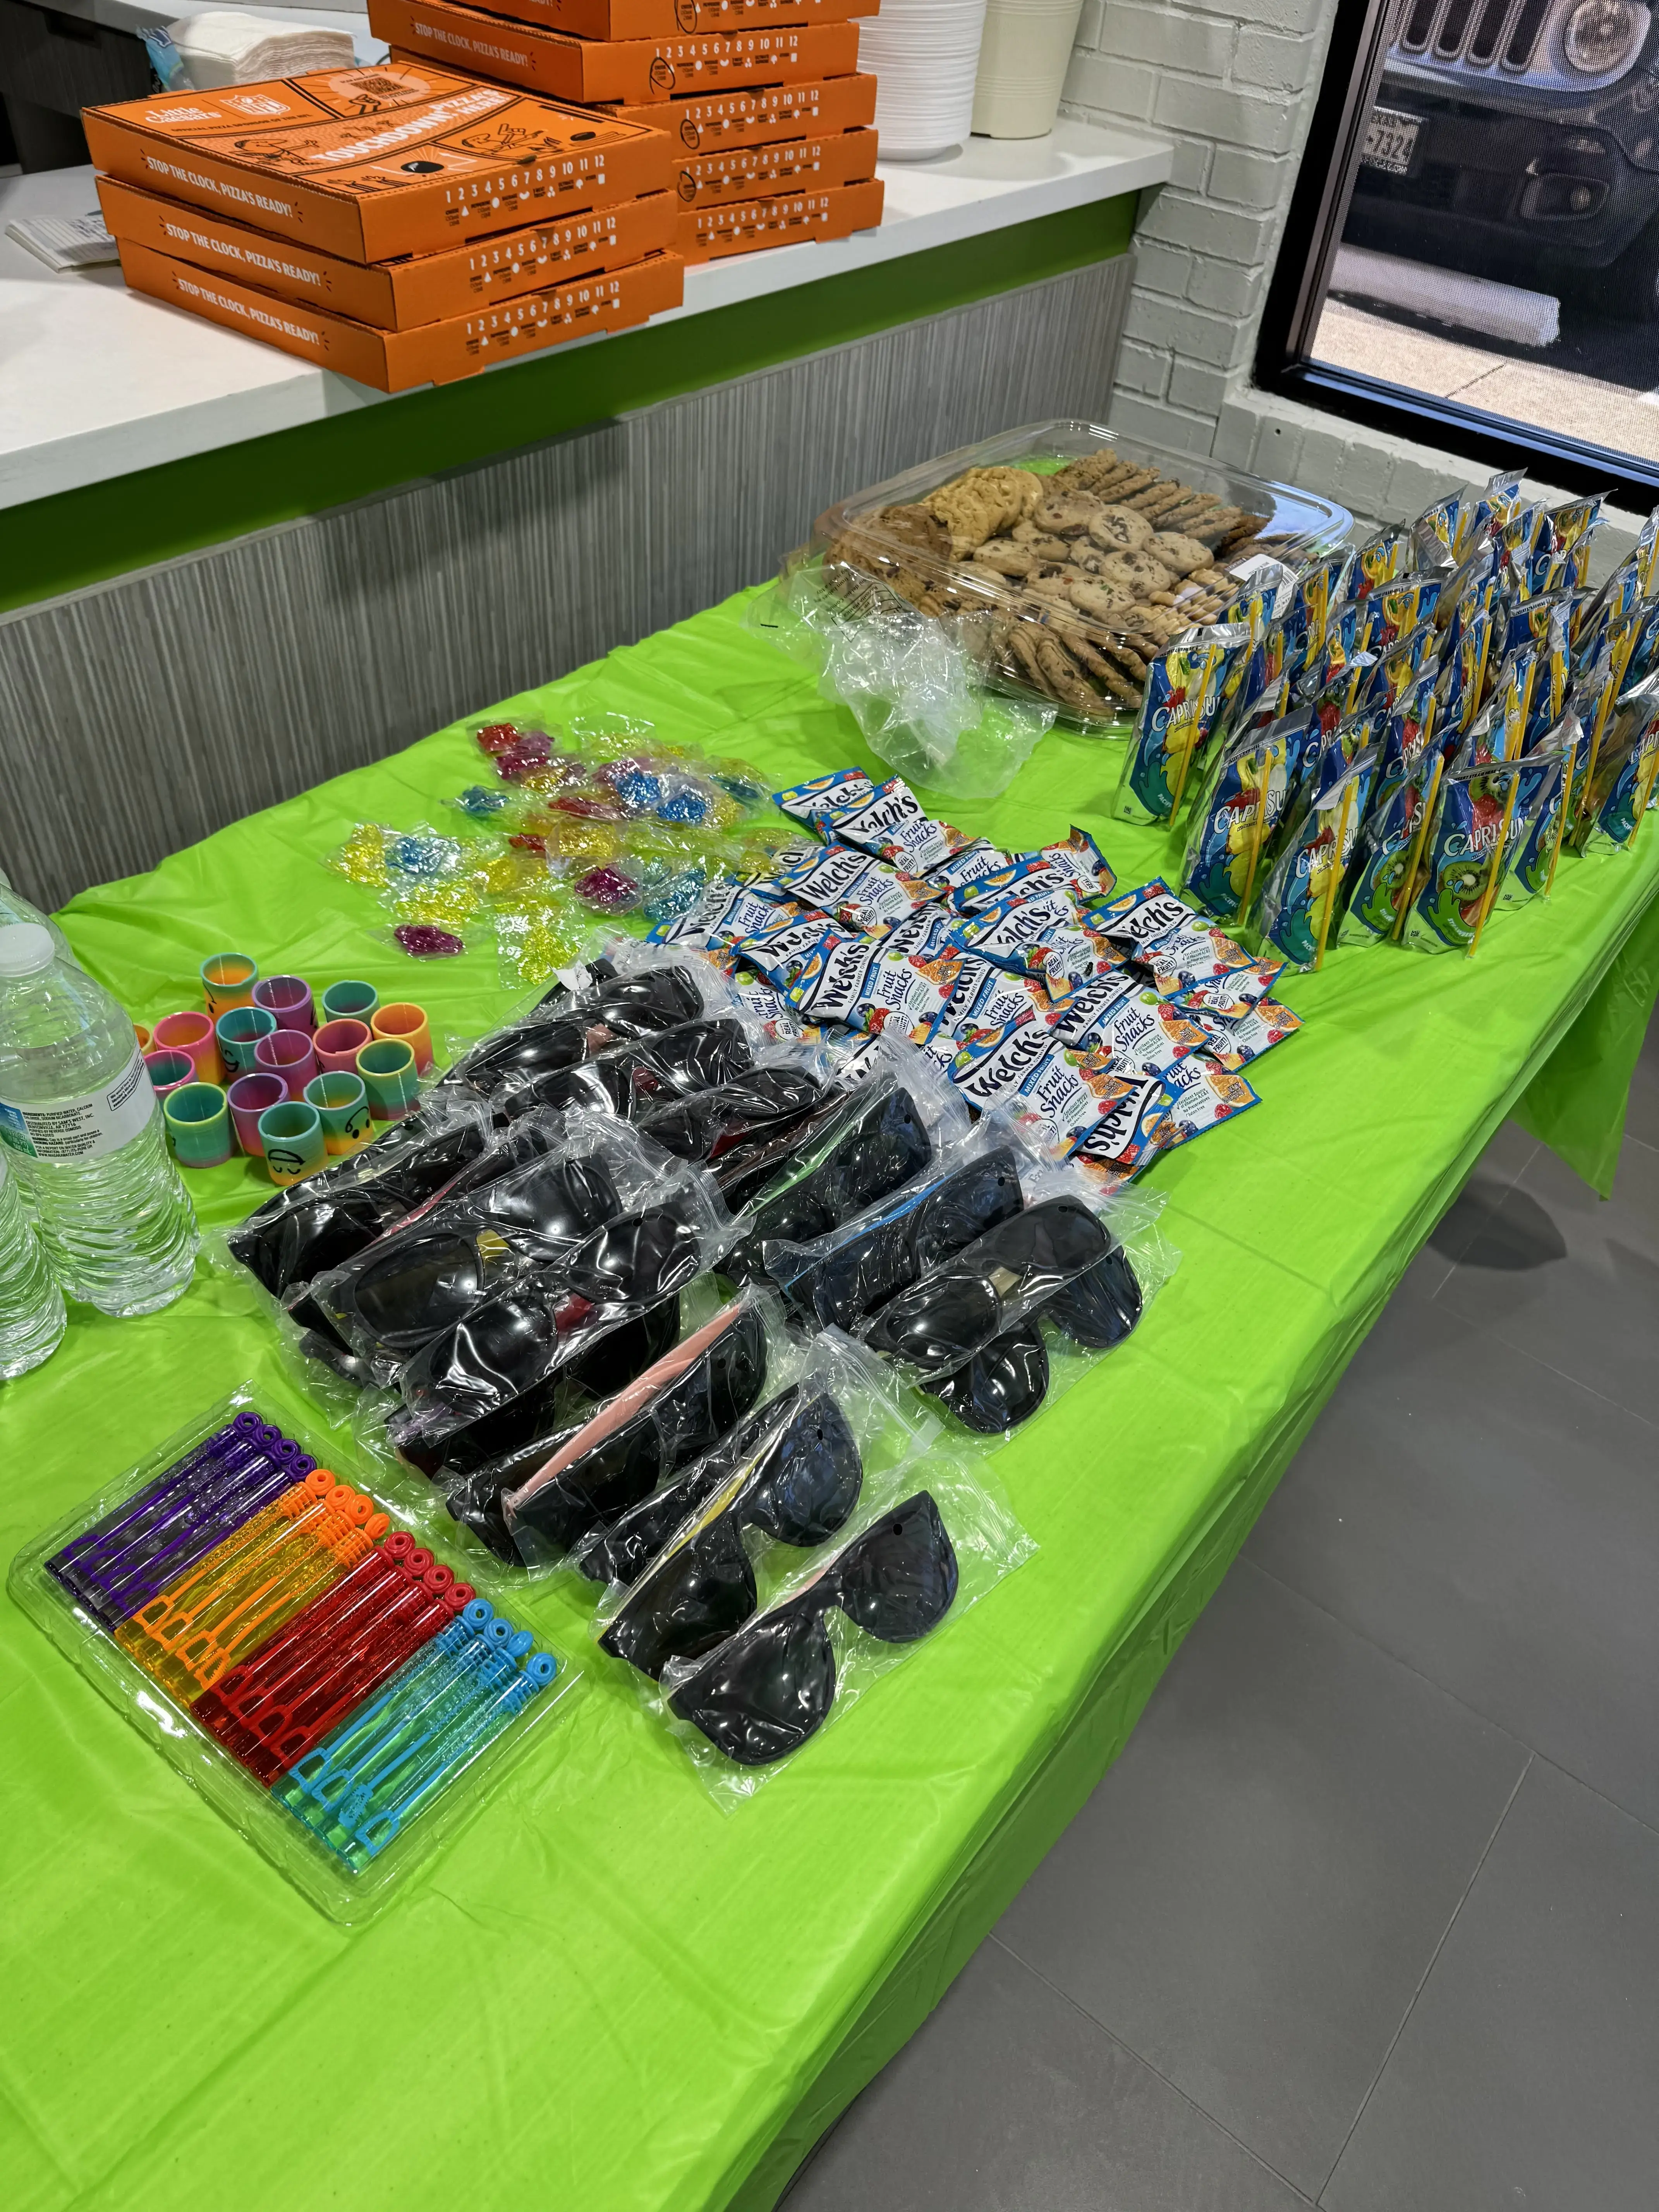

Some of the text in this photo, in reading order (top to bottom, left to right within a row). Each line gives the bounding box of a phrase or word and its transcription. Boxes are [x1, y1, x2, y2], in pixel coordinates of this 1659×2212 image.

[415, 22, 528, 66] STOP THE CLOCK, PIZZA'S READY!
[656, 35, 798, 59] 1 2 3 4 5 6 7 8 9 10 11 12
[145, 107, 203, 117] Little
[427, 88, 500, 113] PIZZA'S
[456, 95, 509, 115] HERE!
[145, 112, 222, 123] Caesars
[313, 108, 458, 162] TOUCHDOWN!
[147, 156, 293, 218] STOP THE CLOCK, PIZZA'S READY!
[446, 154, 605, 203] 1 2 3 4 5 6 7 8 9 10 11 12
[166, 223, 321, 287] STOP THE CLOCK, PIZZA'S READY!
[178, 278, 320, 345] STOP THE CLOCK, PIZZA'S READY!
[903, 823, 937, 852] Snacks
[1444, 826, 1497, 857] CAPRI
[899, 856, 909, 867] REAL
[950, 859, 965, 872] MIXED
[960, 856, 989, 883] Fruit
[1049, 852, 1081, 878] Snacks
[796, 853, 867, 900] Welch's
[856, 876, 880, 896] Fruit
[1084, 877, 1095, 889] REAL
[860, 879, 894, 905] Snacks
[738, 902, 758, 927] Fruit
[745, 905, 773, 933] Snack
[1048, 957, 1059, 967] REAL
[1049, 962, 1062, 975] FRUIT!
[1157, 960, 1175, 974] FRUIT!
[848, 956, 869, 1003] FAMILY FARMER OWNED
[864, 966, 879, 997] MIXED FRUIT
[877, 969, 896, 999] Fruit
[885, 969, 912, 1010] Snacks
[967, 983, 979, 1003] FARMER
[972, 980, 993, 1017] MIXED FRUIT
[984, 989, 1009, 1020] Fruit
[1055, 974, 1129, 1033] Welch's
[1114, 998, 1127, 1013] FRUIT
[1218, 995, 1228, 1009] FRUIT!
[991, 993, 1025, 1027] Snacks
[1082, 987, 1123, 1029] FAMILY FARMER OWNED
[784, 1022, 792, 1035] REAL
[789, 1022, 799, 1037] FRUIT!
[1113, 1007, 1140, 1035] Fruit
[1115, 1013, 1155, 1053] Snacks
[1207, 1033, 1221, 1048] REAL
[1213, 1037, 1228, 1054] FRUIT!
[964, 1029, 1051, 1097] Welch's
[1018, 1062, 1034, 1079] FARMER
[1024, 1057, 1050, 1093] MIXED FRUIT
[1166, 1063, 1187, 1079] ruit
[1036, 1065, 1065, 1101] Fruit
[1174, 1068, 1201, 1088] acks
[77, 1104, 93, 1112] CALCIUM
[1041, 1075, 1079, 1118] Snacks
[1179, 1088, 1206, 1104] Excellent Source
[1184, 1097, 1198, 1106] Vitamins
[1188, 1096, 1210, 1110] Preservatives
[1186, 1109, 1198, 1118] Gluten
